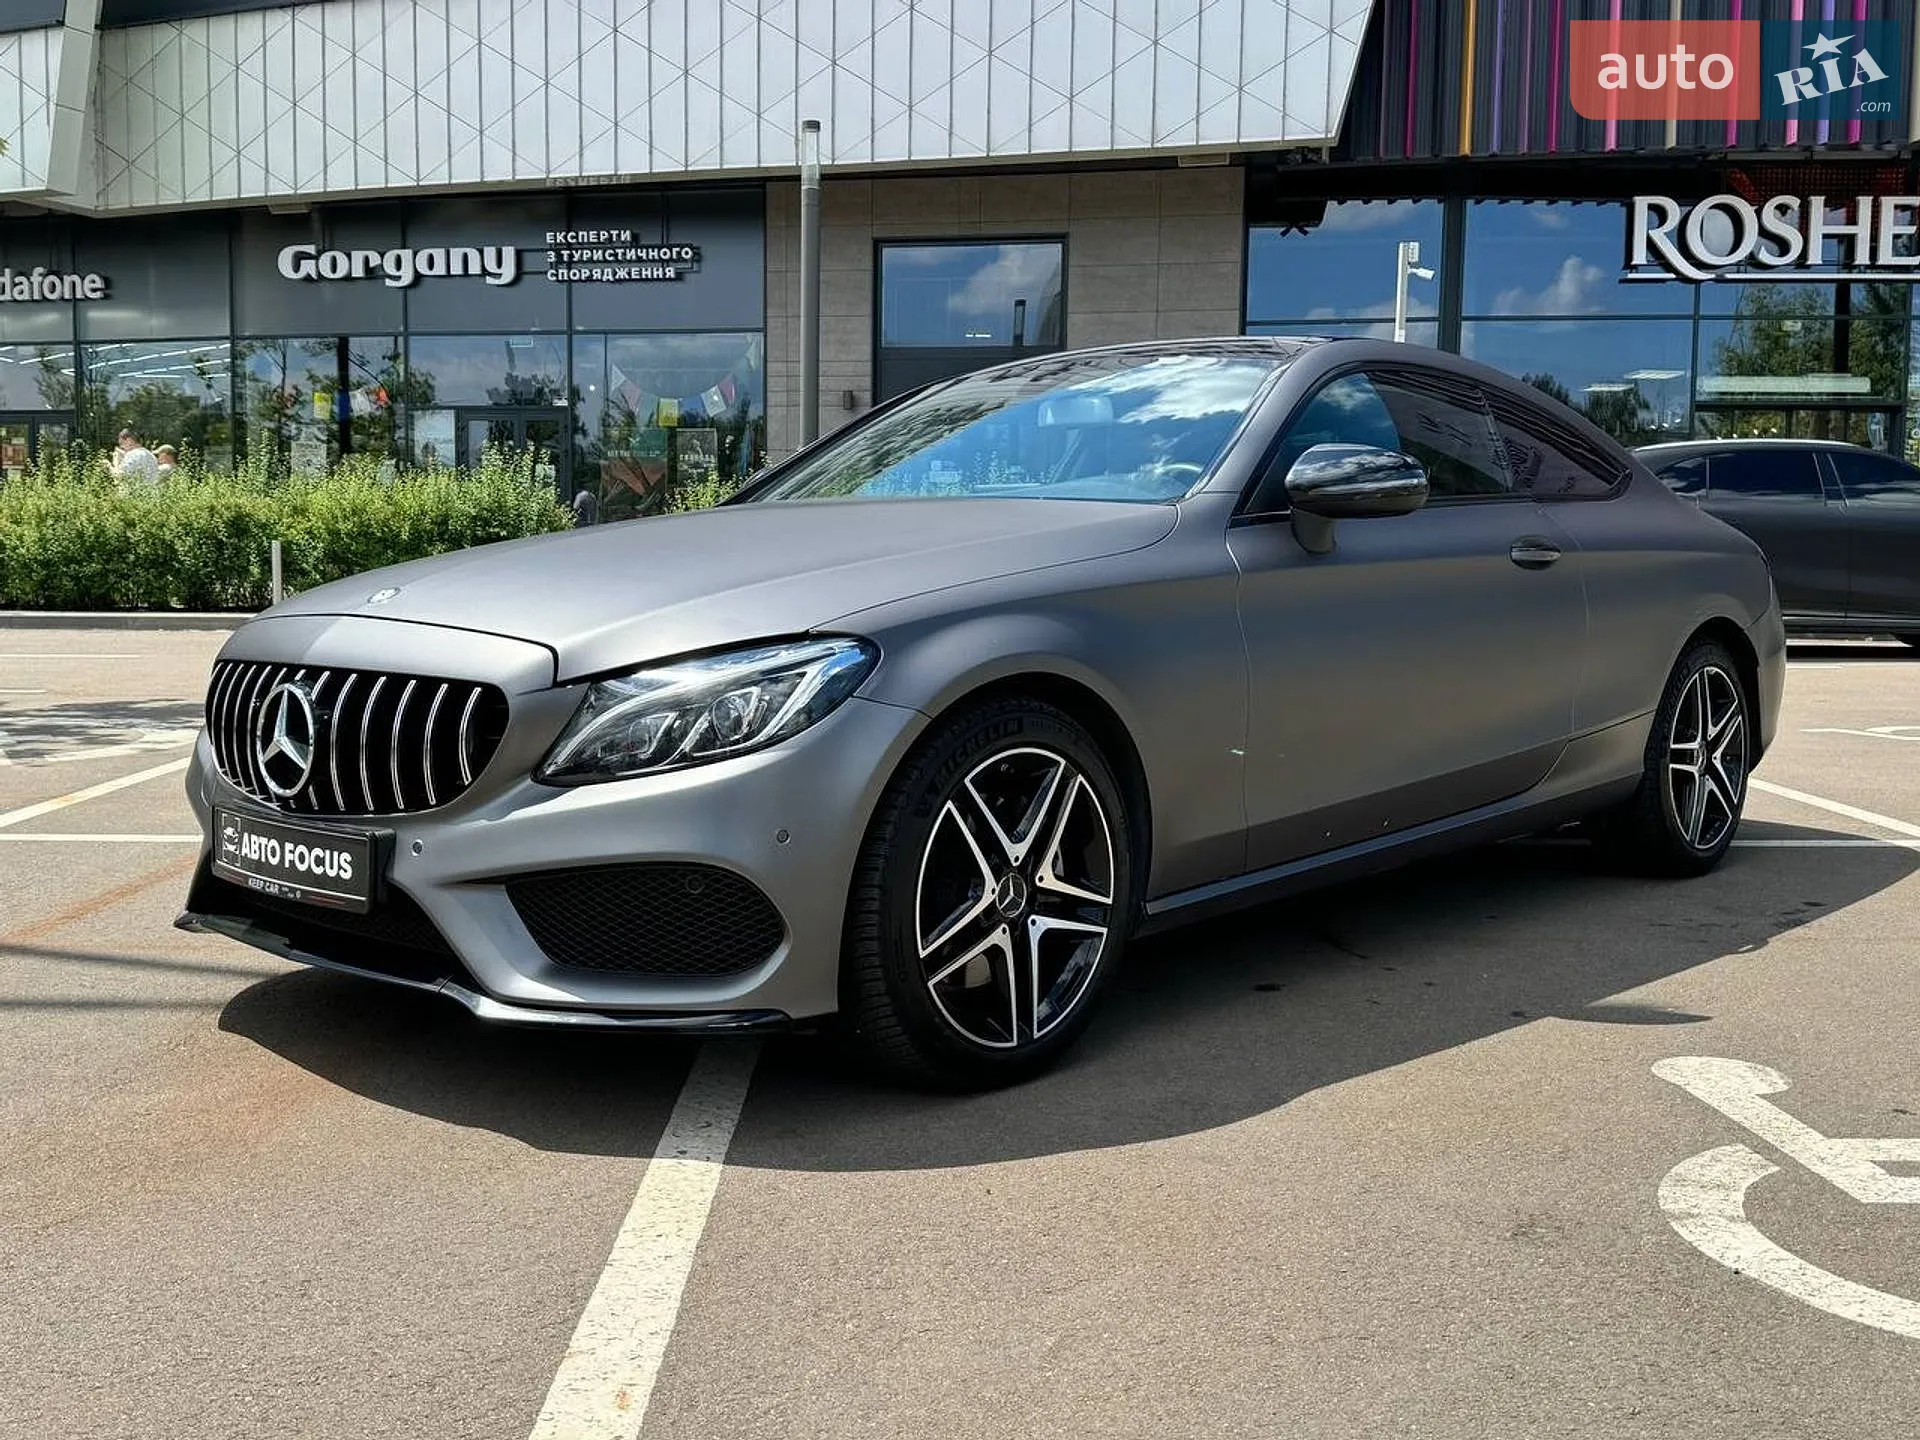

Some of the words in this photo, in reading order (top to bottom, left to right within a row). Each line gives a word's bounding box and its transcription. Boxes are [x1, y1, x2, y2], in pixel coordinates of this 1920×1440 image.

[545, 230, 633, 244] ЕКСПЕРТИ
[561, 247, 694, 263] ТУРИСТИЧНОГО
[277, 244, 517, 288] Gorgany
[547, 267, 676, 282] СПОРЯДЖЕННЯ
[284, 841, 353, 880] FOCUS
